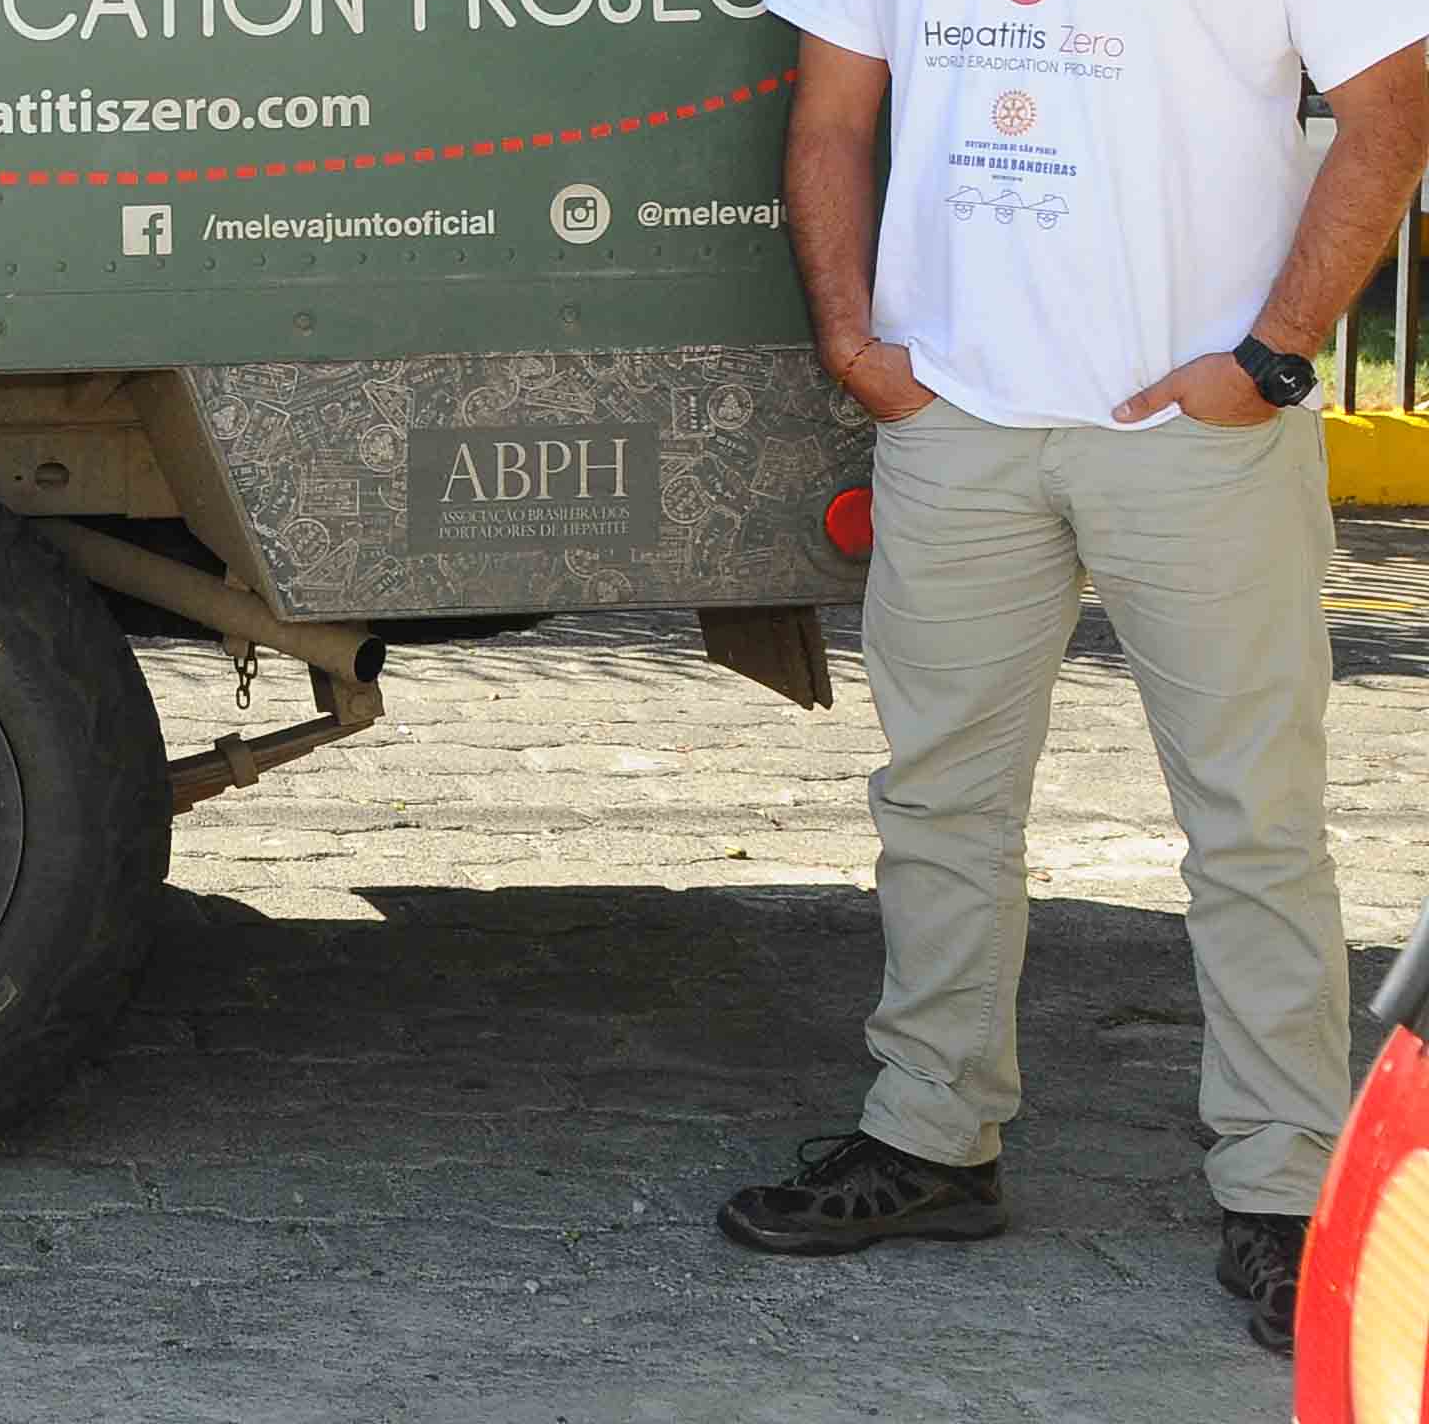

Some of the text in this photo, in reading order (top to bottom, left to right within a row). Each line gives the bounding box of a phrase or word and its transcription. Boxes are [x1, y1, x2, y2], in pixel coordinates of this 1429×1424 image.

[924, 21, 1125, 57] Hepatitis Zero
[968, 56, 1059, 73] ERADICATION
[202, 206, 496, 246] /melevajuntooficial
[439, 437, 631, 503] ABPH
